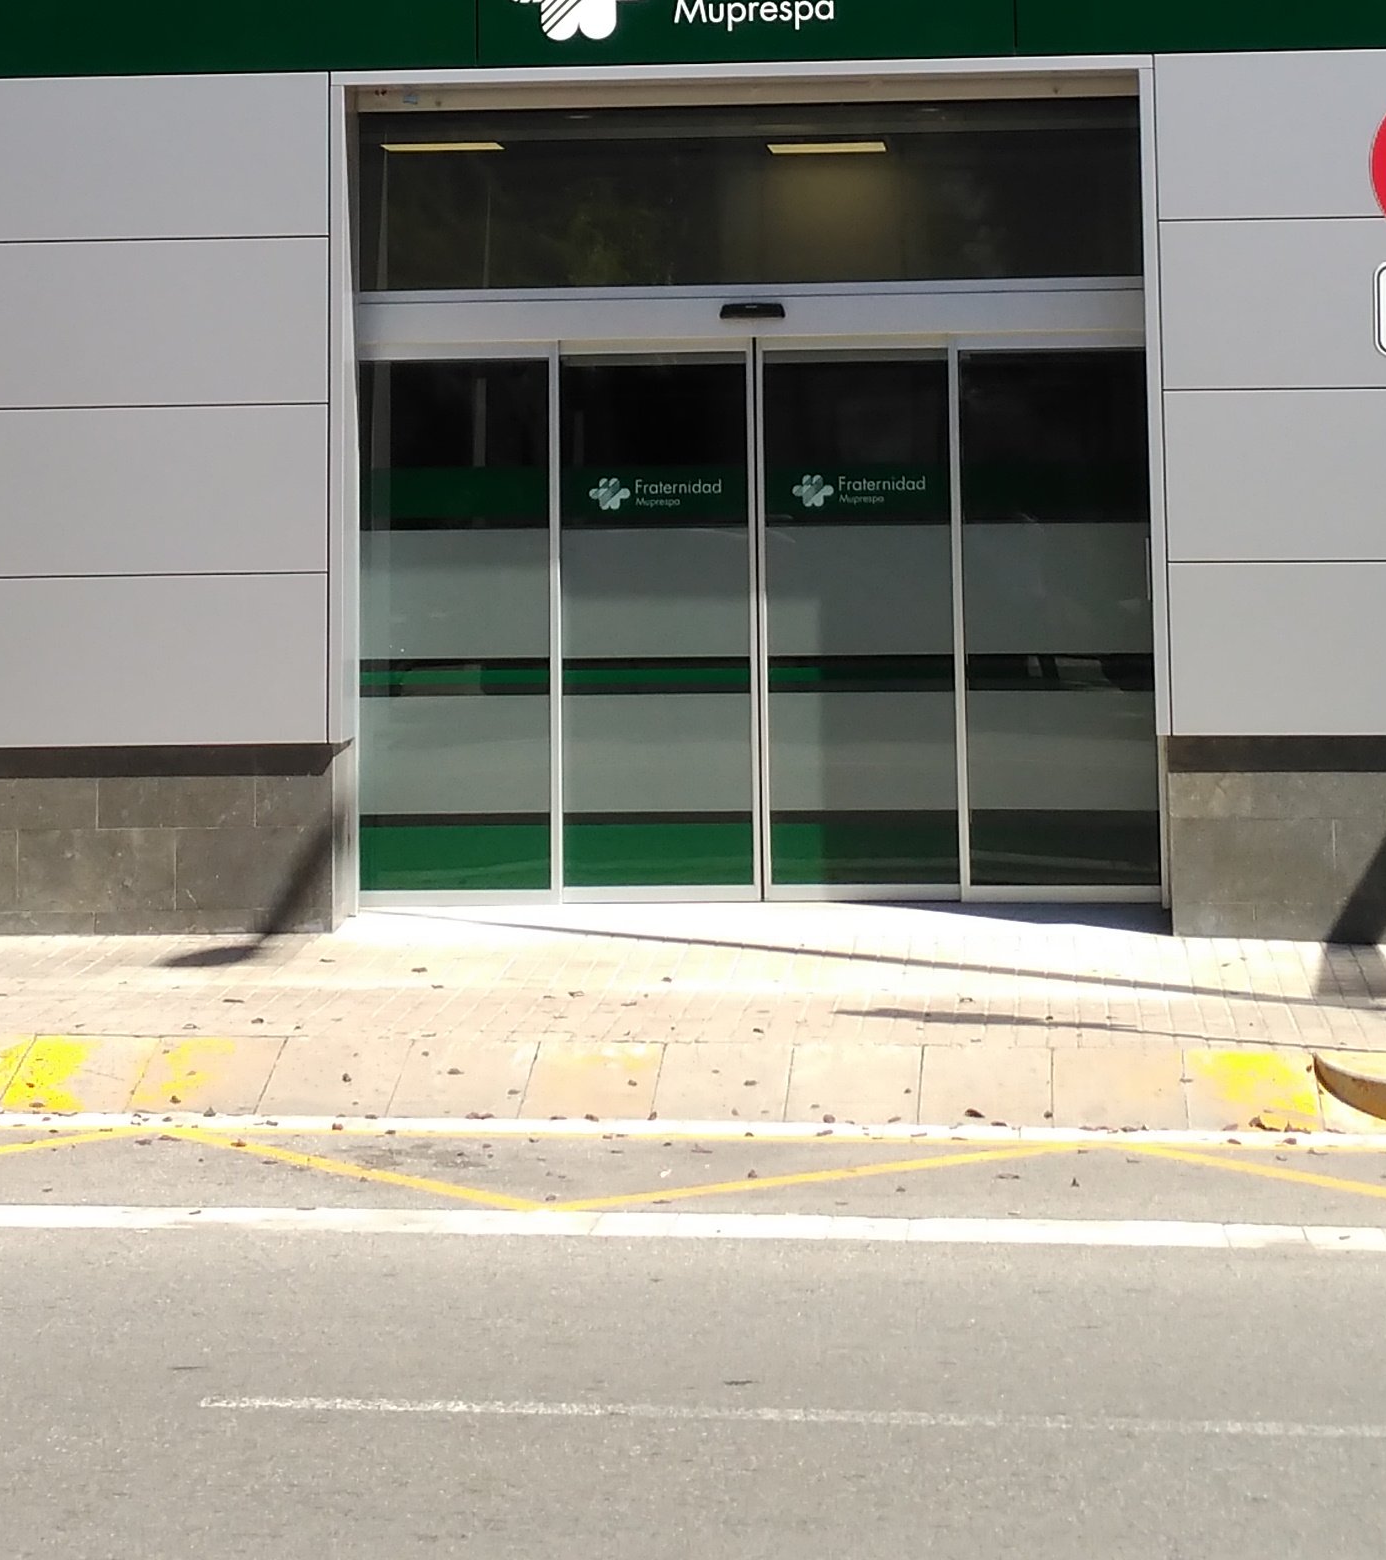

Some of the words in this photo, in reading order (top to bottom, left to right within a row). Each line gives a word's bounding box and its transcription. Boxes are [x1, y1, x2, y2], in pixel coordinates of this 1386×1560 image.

[635, 479, 722, 495] Fraternidad
[838, 475, 926, 492] Fraternidad
[635, 496, 681, 508] Muprespa
[839, 493, 885, 505] Muprespa
